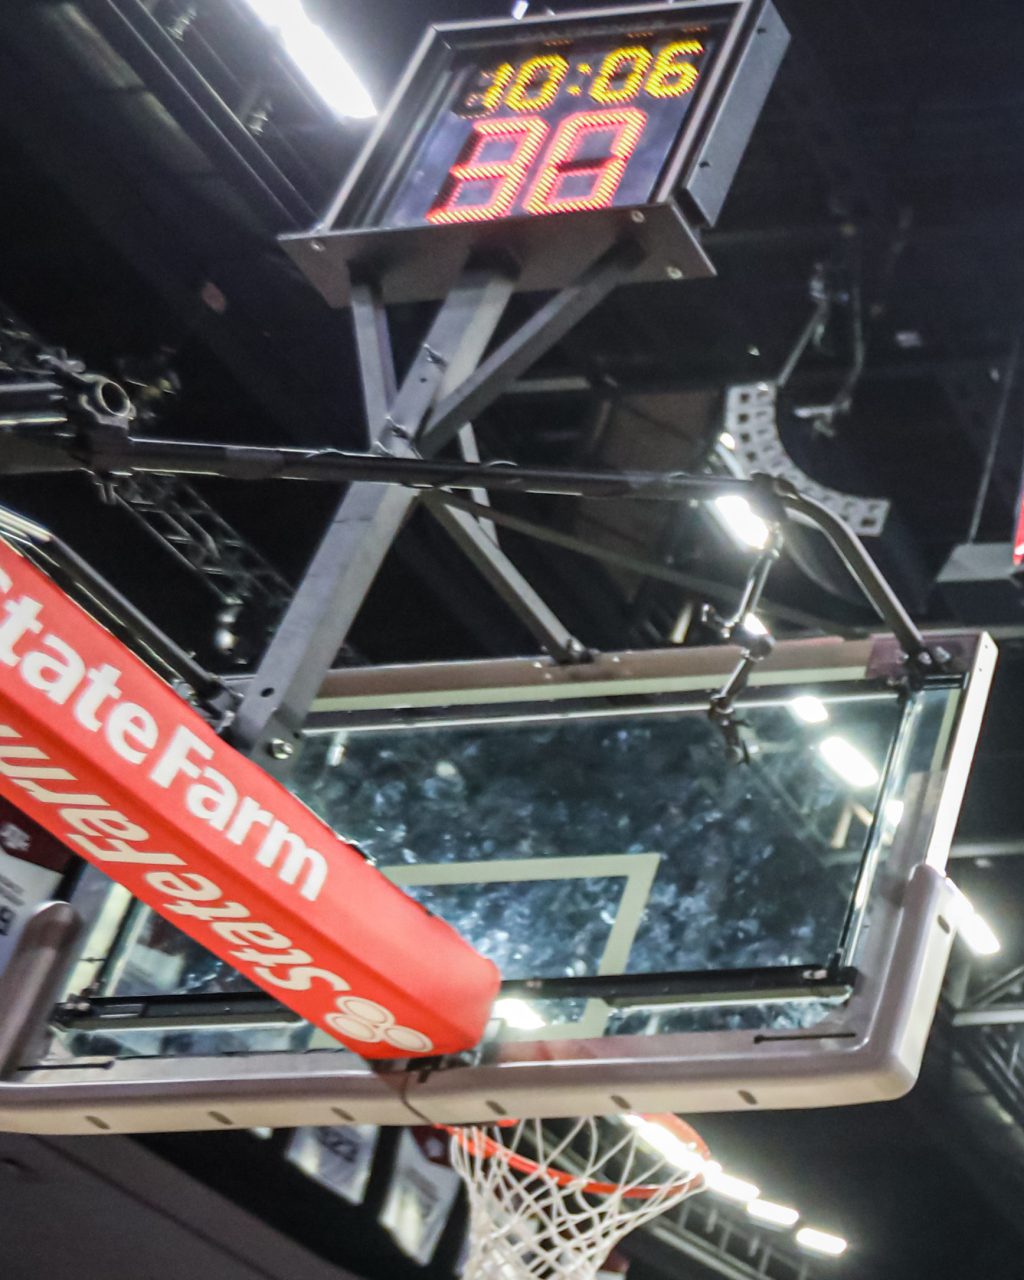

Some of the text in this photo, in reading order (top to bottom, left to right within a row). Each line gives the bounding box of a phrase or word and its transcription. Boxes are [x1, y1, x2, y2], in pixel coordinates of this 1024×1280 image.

[482, 40, 705, 112] 10:06
[425, 107, 648, 224] 30
[0, 568, 329, 901] tateFarm
